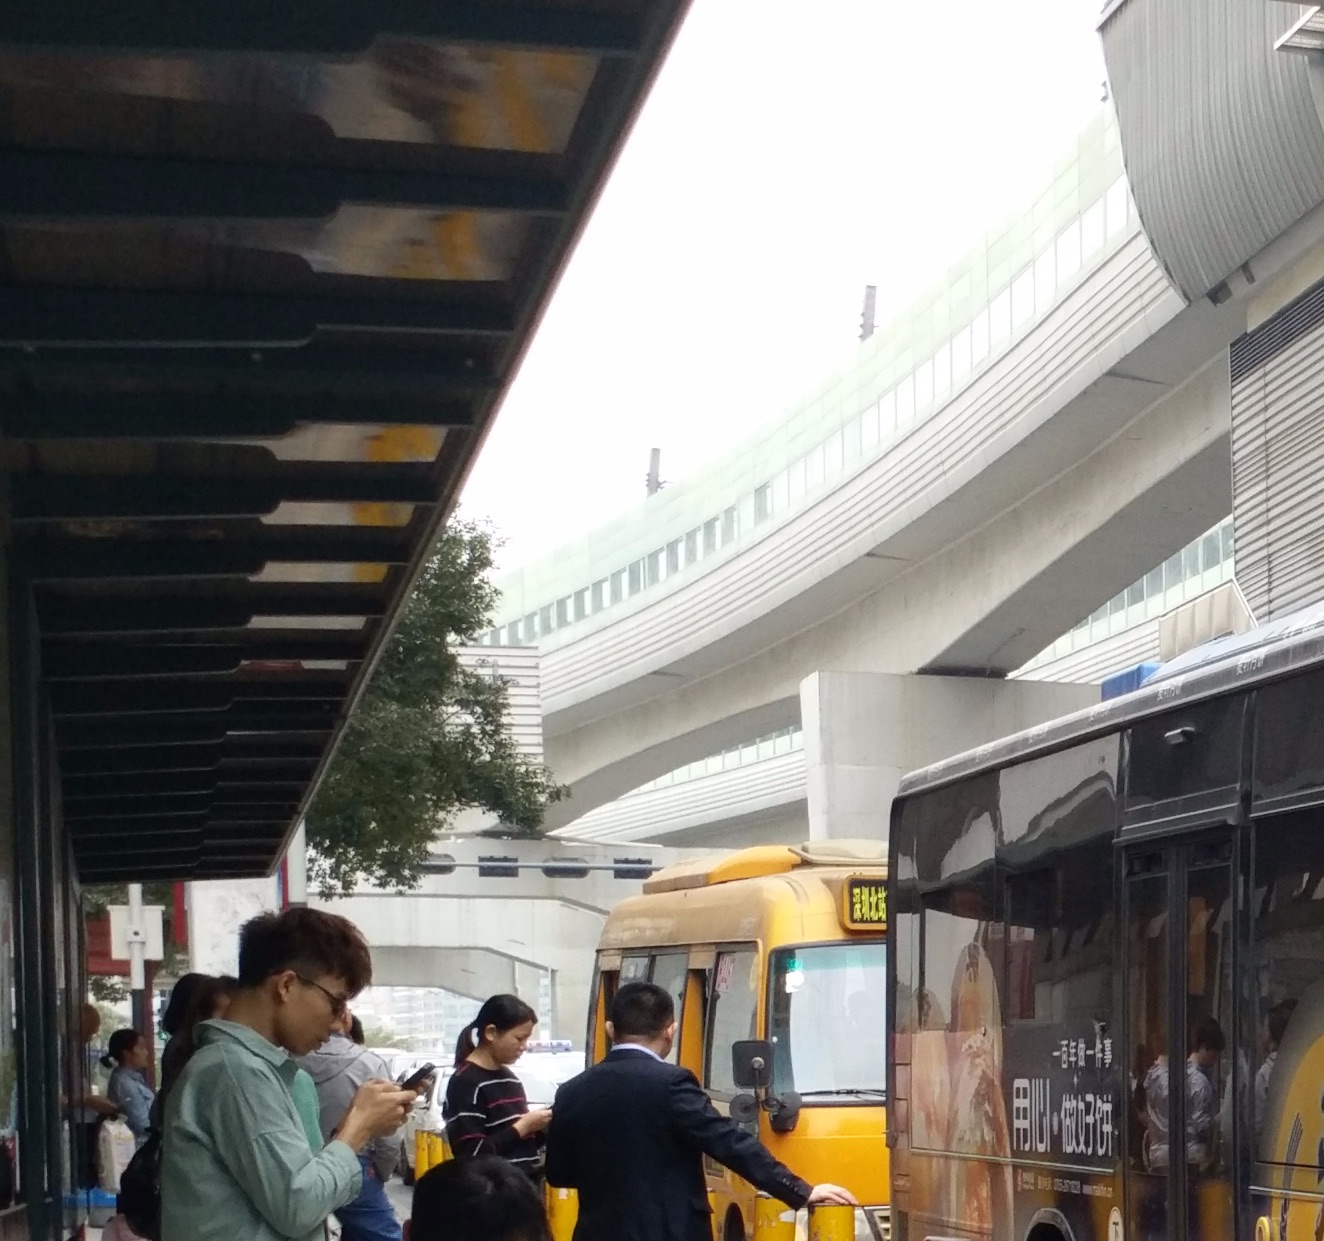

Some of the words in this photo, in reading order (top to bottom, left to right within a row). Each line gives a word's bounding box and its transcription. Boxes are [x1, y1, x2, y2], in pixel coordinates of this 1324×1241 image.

[1052, 1037, 1113, 1069] 一百年做一件事
